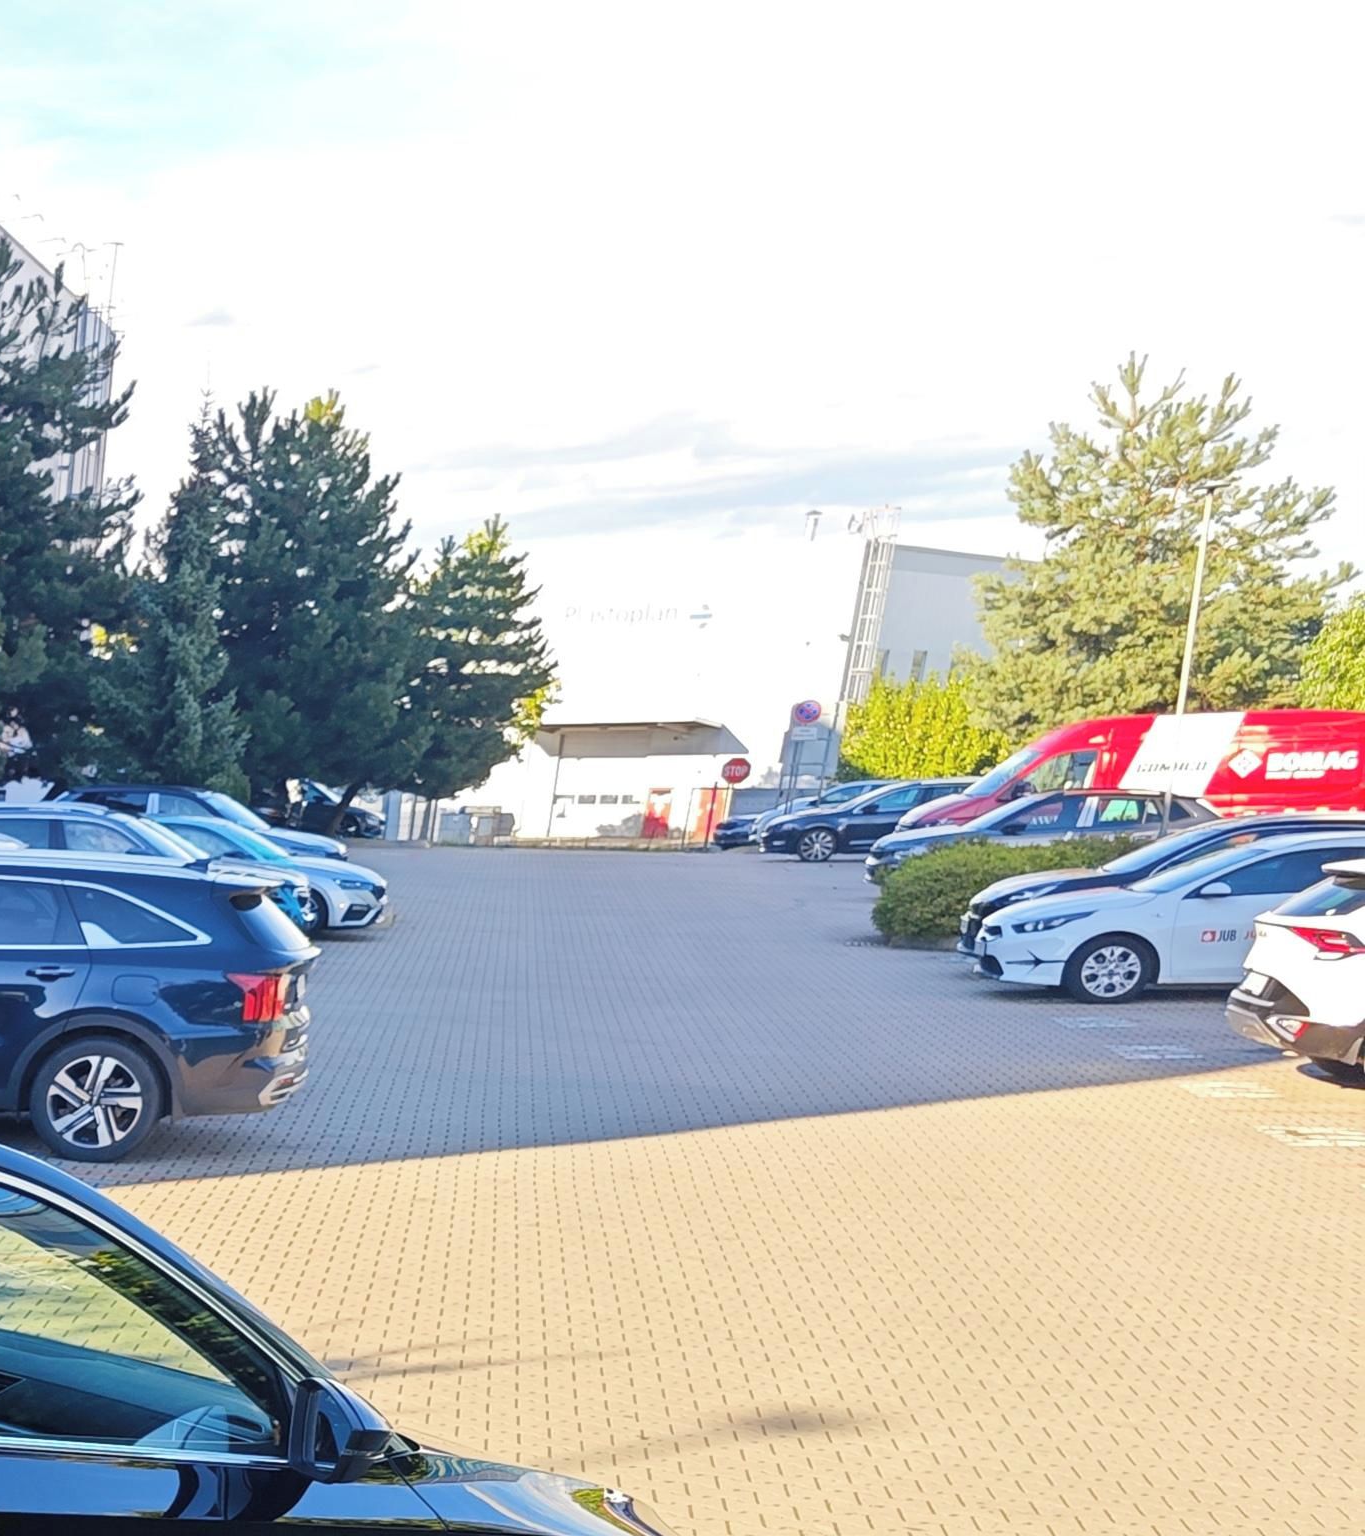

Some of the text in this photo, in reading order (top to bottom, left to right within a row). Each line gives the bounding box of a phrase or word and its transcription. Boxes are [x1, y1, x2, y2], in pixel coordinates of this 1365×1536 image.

[1267, 751, 1358, 772] BOMAG
[723, 766, 748, 777] STOP
[1217, 929, 1237, 942] JUB
